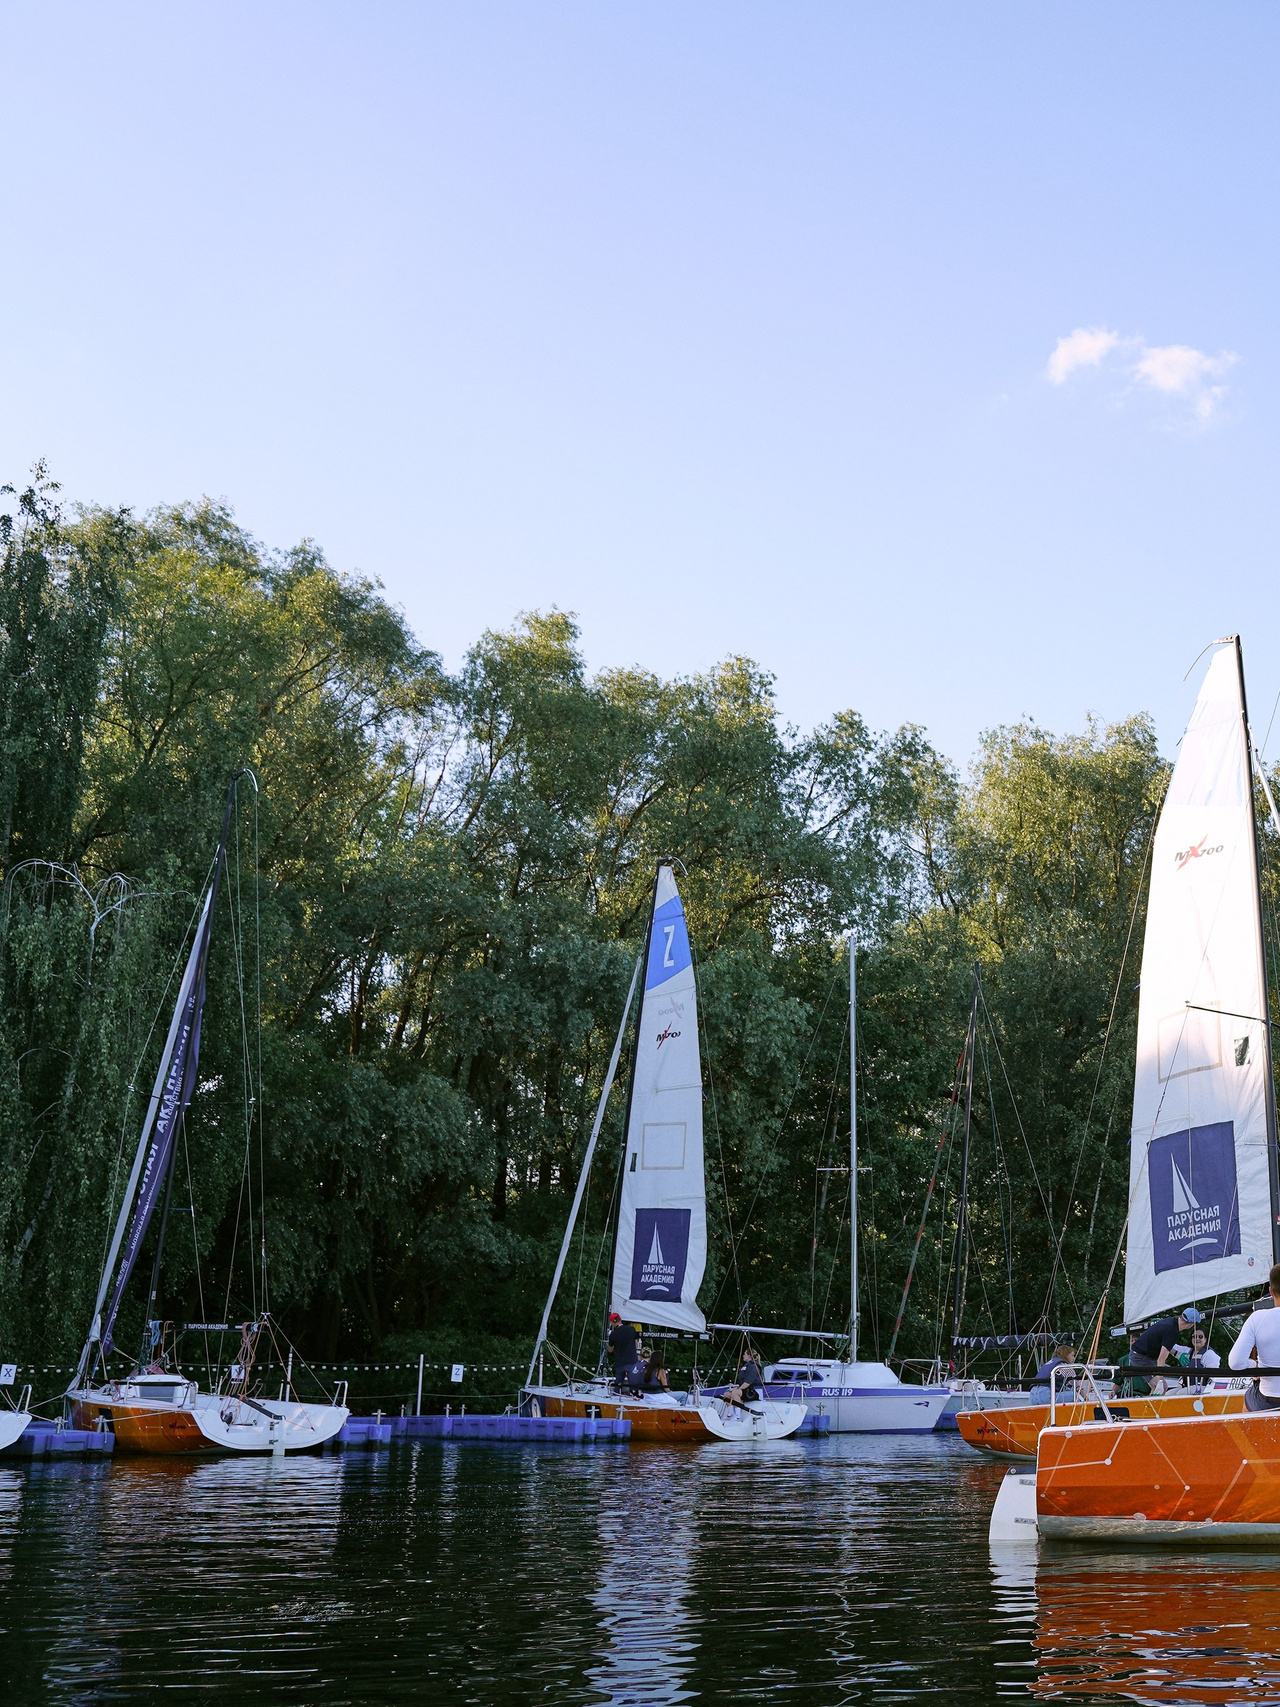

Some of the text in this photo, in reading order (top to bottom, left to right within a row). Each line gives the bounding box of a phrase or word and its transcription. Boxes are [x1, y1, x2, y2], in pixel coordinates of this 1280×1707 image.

[1174, 834, 1224, 872] MX700
[663, 925, 675, 968] Z
[1167, 1205, 1220, 1227] ПАРУСНАЯ
[1168, 1219, 1222, 1242] АКАДЕМИЯ
[642, 1265, 675, 1274] ПАРУСНАЯ
[641, 1274, 674, 1284] АКАДЕМИЯ
[4, 1368, 12, 1377] X
[821, 1388, 853, 1396] RUS 119
